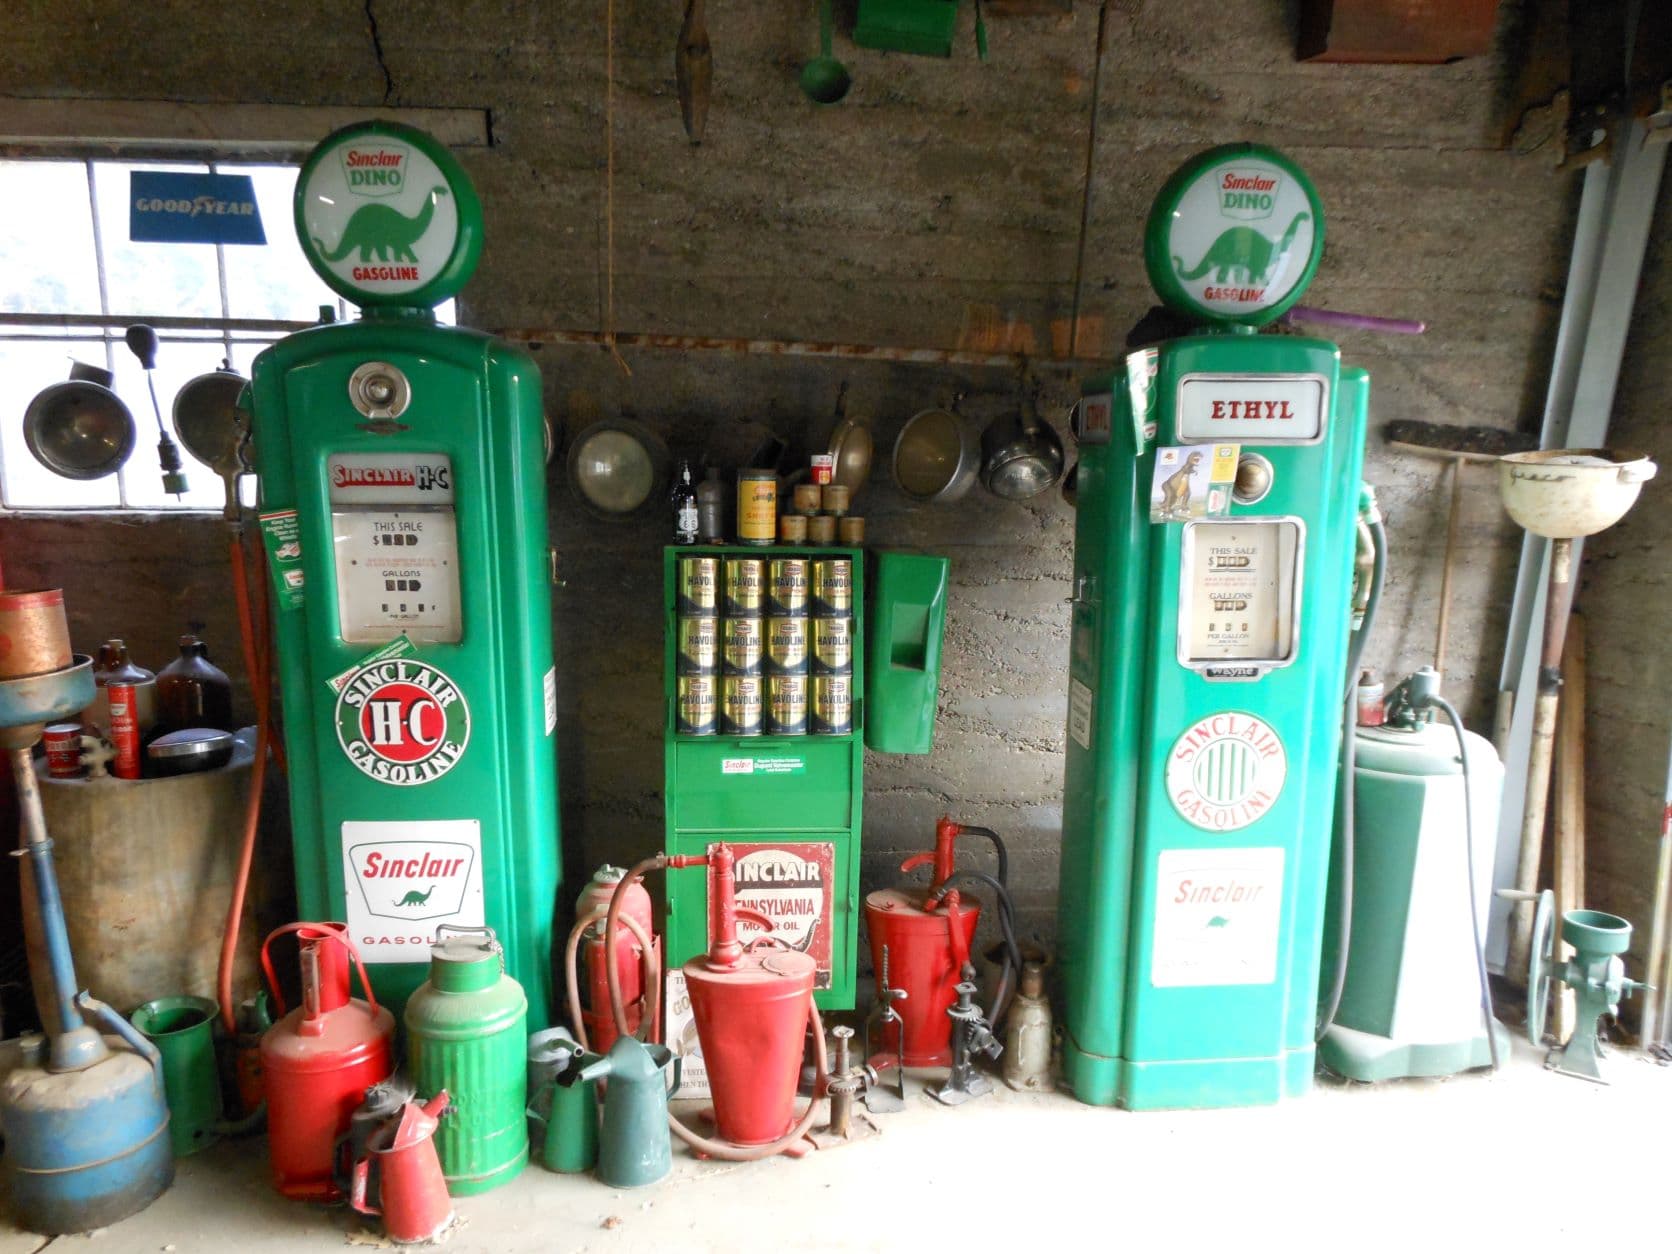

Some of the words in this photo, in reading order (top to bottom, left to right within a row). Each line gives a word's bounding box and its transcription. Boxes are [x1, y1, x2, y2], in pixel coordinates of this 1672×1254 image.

[346, 150, 404, 167] Sinclair
[350, 169, 402, 186] DINO
[1222, 173, 1277, 191] Sinclair
[1223, 192, 1273, 210] DINO
[352, 266, 419, 281] GASOLINE
[1211, 400, 1295, 419] ETHYL
[332, 464, 415, 488] SINCLAIR
[374, 522, 396, 532] THIS
[400, 522, 423, 532] SALE
[1209, 592, 1252, 600] GALLONS
[344, 662, 458, 709] SINCLAIR
[1176, 715, 1280, 762] SINCLAIR
[348, 740, 463, 783] GASOLINE
[363, 851, 464, 878] Sinclair
[735, 862, 820, 882] INCLAIR
[1174, 879, 1265, 904] Sinclair
[743, 922, 781, 931] MOR
[783, 921, 801, 931] OIL
[362, 936, 439, 945] GASOL
